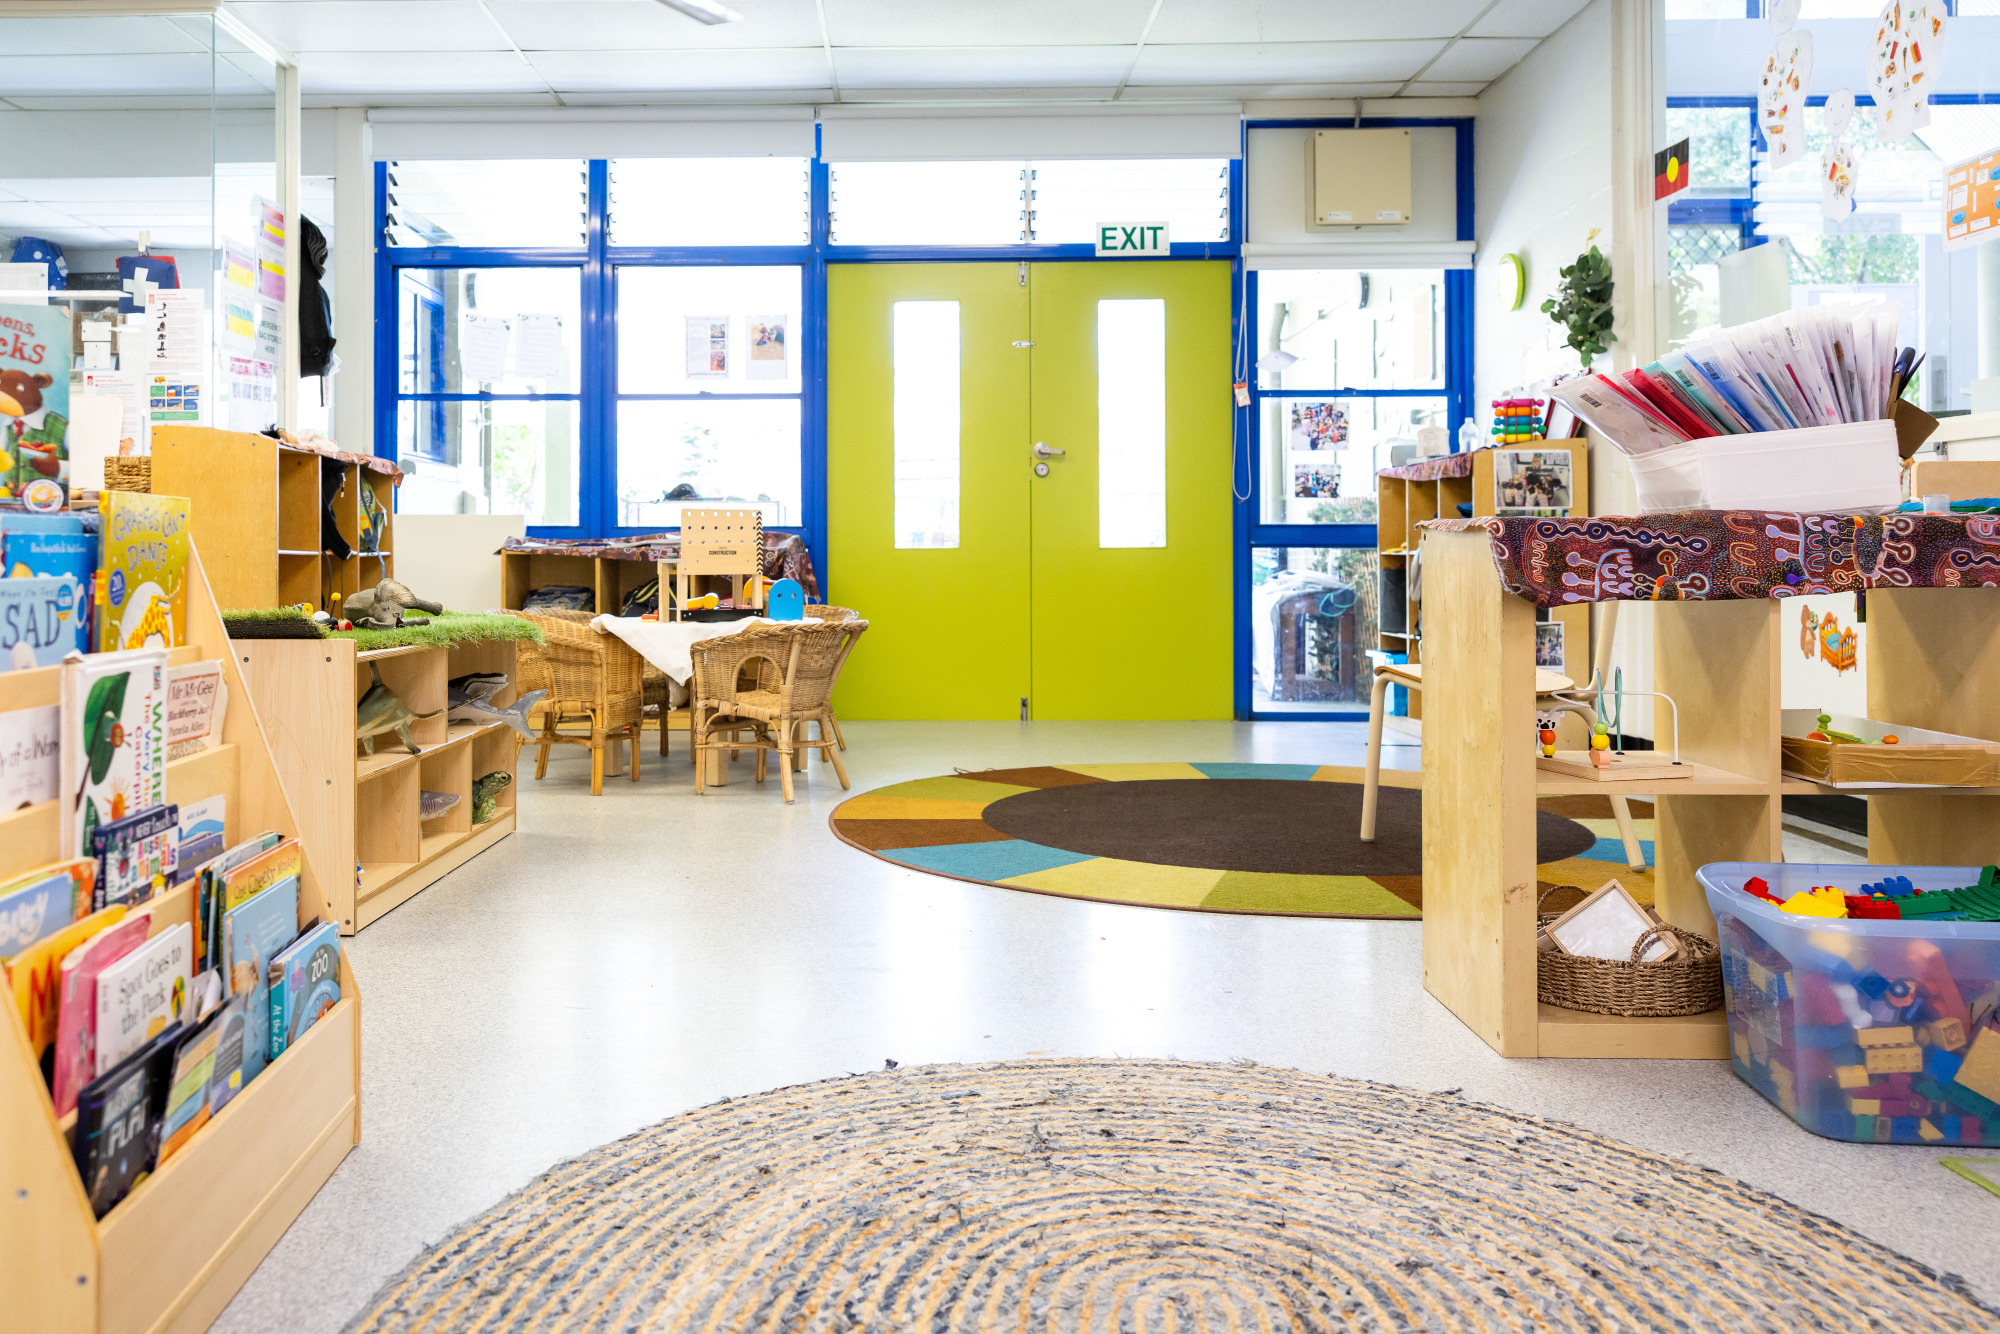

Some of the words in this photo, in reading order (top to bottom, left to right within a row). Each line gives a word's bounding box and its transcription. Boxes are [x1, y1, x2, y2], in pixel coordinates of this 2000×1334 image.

[1101, 226, 1164, 250] EXIT
[0, 315, 36, 337] ens,
[127, 541, 168, 573] DANCE
[2, 600, 60, 650] SAD
[152, 701, 163, 807] WHERE
[119, 973, 143, 1007] Spot
[145, 957, 170, 983] Goes
[171, 946, 182, 965] to
[311, 953, 328, 983] ZOO
[121, 1007, 138, 1035] the
[142, 983, 166, 1018] Park
[273, 1004, 283, 1015] At
[273, 1022, 282, 1034] the
[273, 1036, 283, 1053] Zoo
